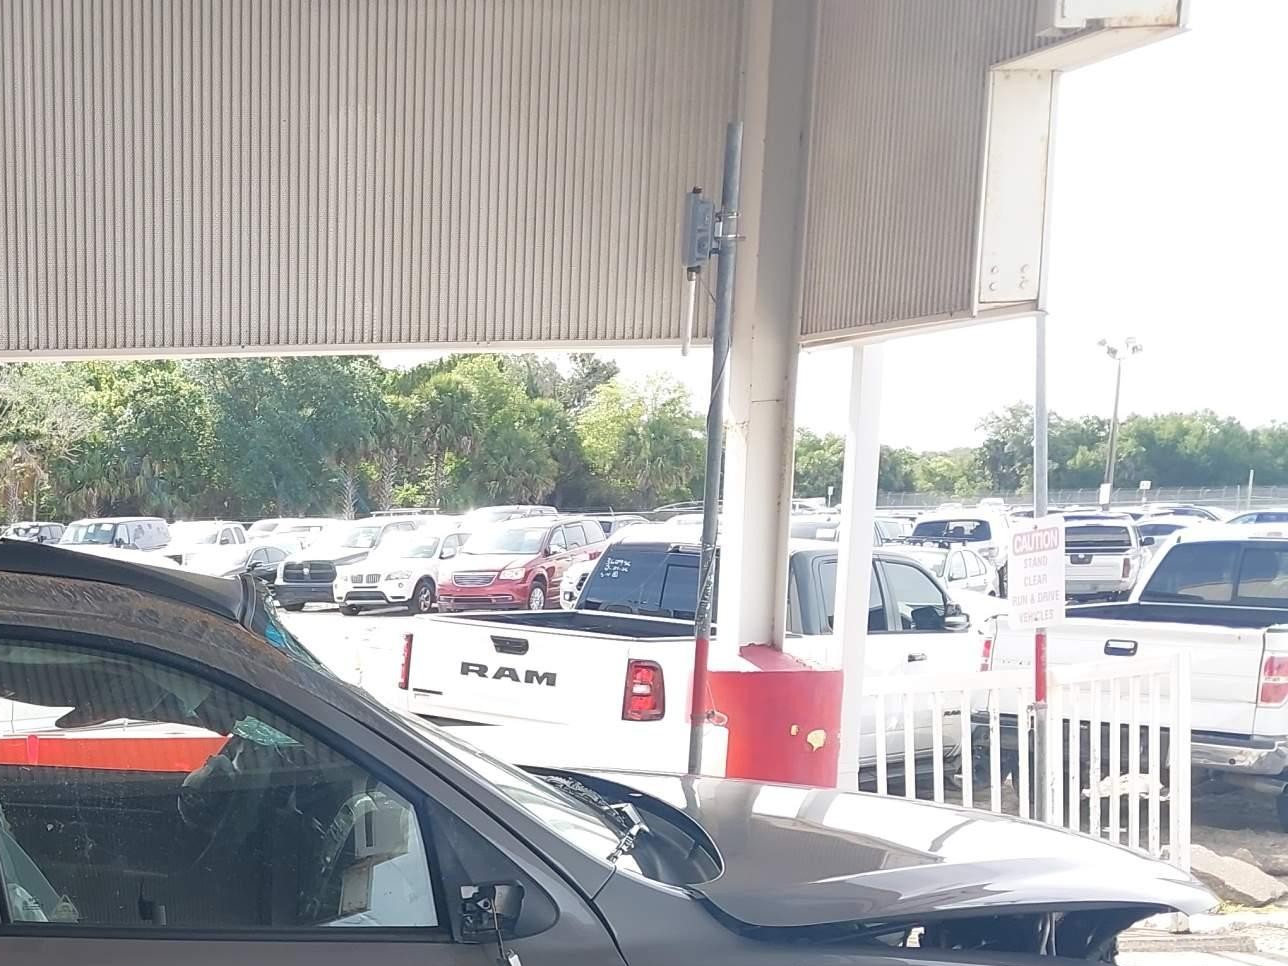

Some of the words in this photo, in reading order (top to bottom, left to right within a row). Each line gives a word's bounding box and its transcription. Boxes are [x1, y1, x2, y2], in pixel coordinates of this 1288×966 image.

[1014, 529, 1058, 553] CAUTION
[1023, 555, 1048, 569] STAND
[1023, 573, 1048, 587] CLEAR
[1012, 594, 1028, 607] RUN
[1037, 589, 1060, 603] DRIVE
[460, 661, 557, 687] RAM
